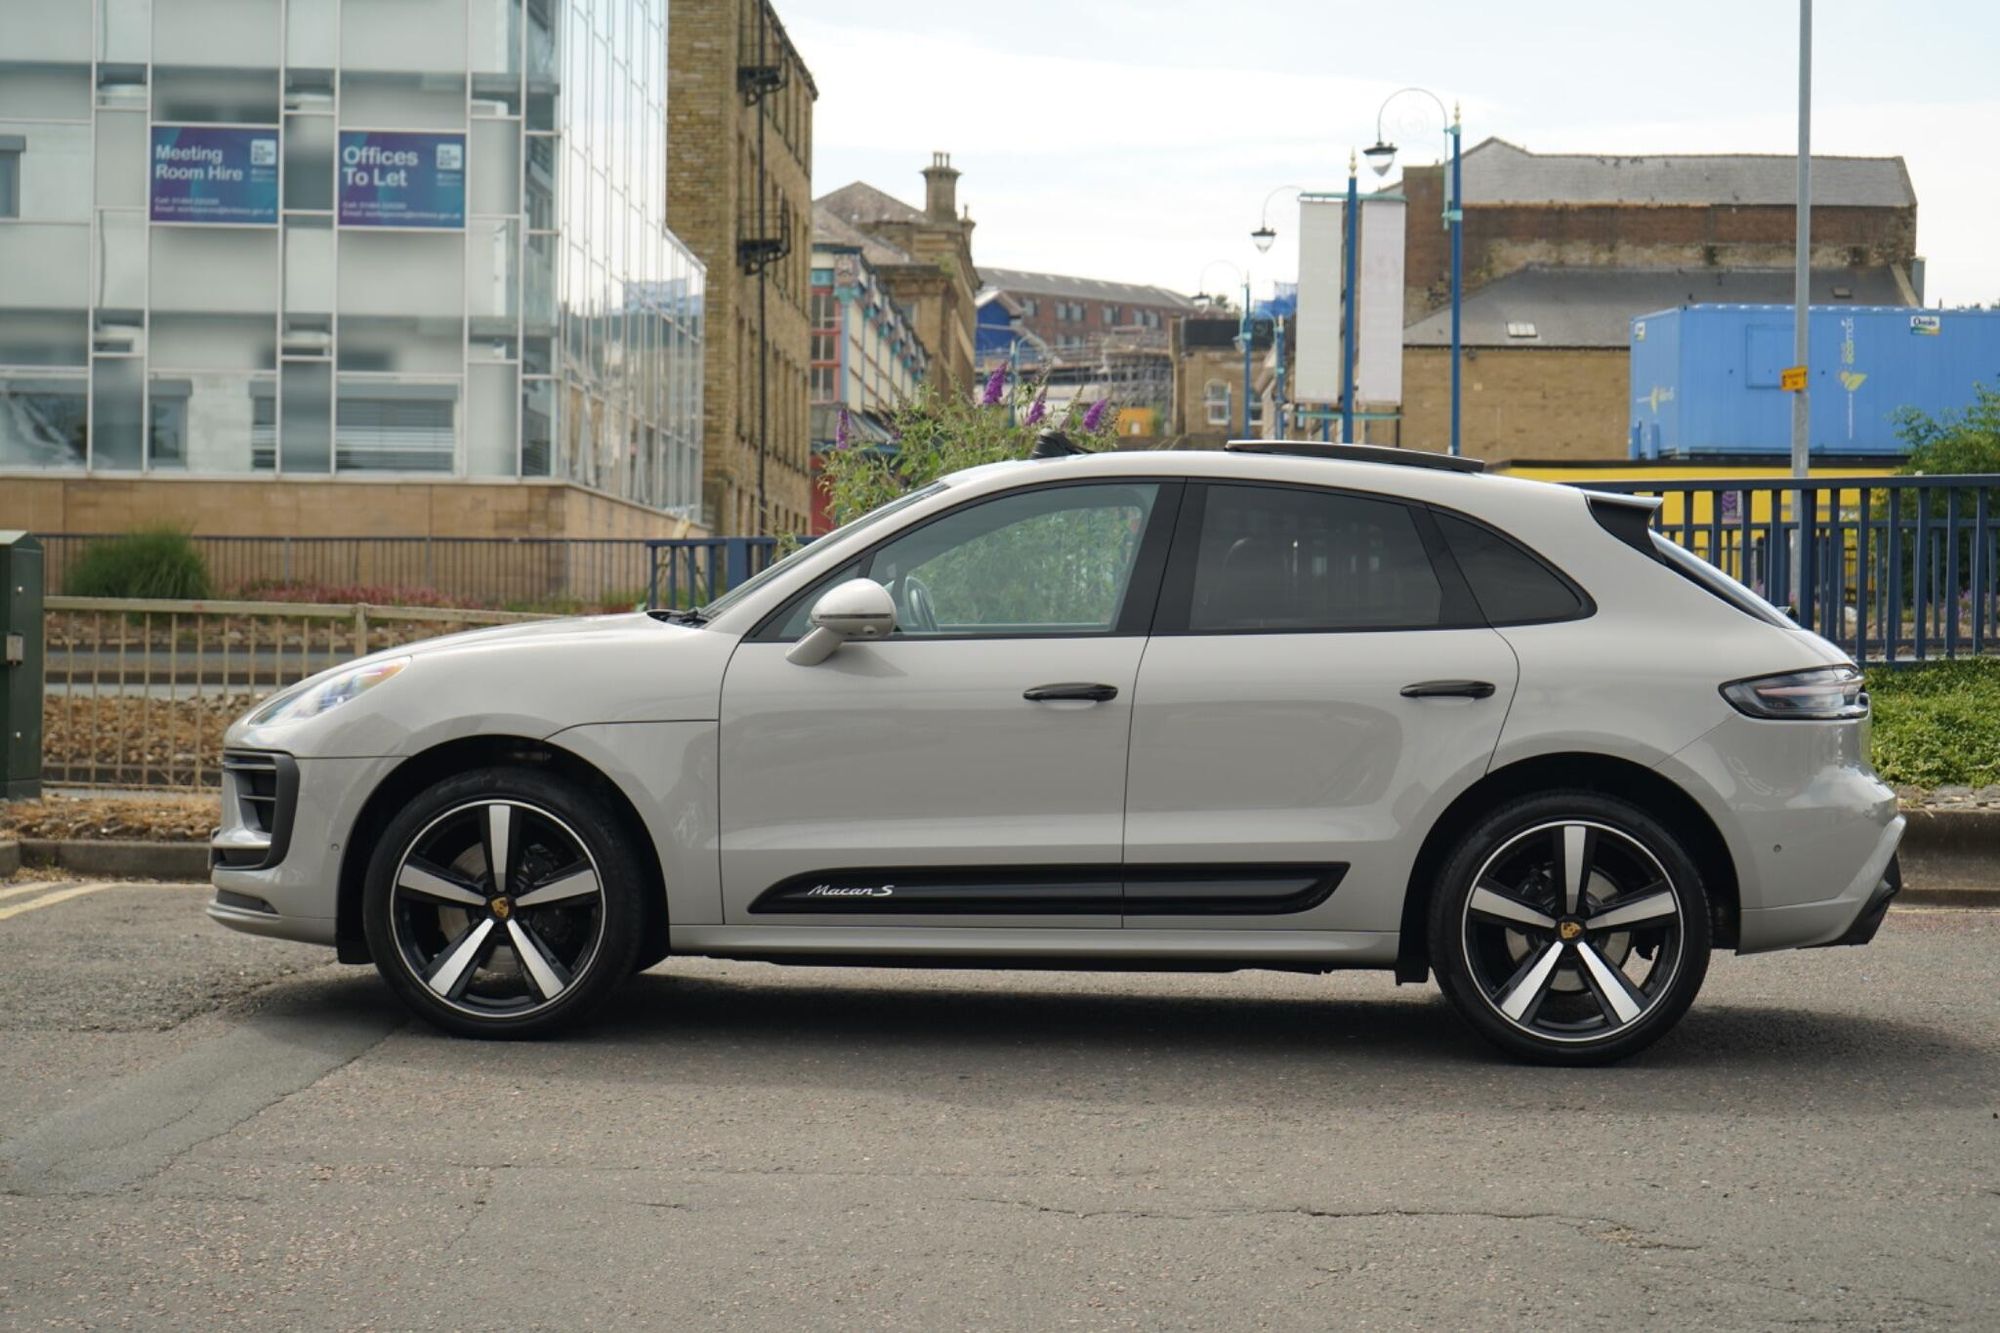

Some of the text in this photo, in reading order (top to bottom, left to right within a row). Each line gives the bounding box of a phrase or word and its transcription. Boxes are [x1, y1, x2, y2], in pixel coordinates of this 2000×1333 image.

[156, 145, 223, 165] Meeting
[343, 145, 418, 166] Offices
[156, 164, 204, 180] Room
[208, 165, 243, 181] Hire
[342, 166, 408, 187] To Let
[807, 884, 895, 897] Macan S
